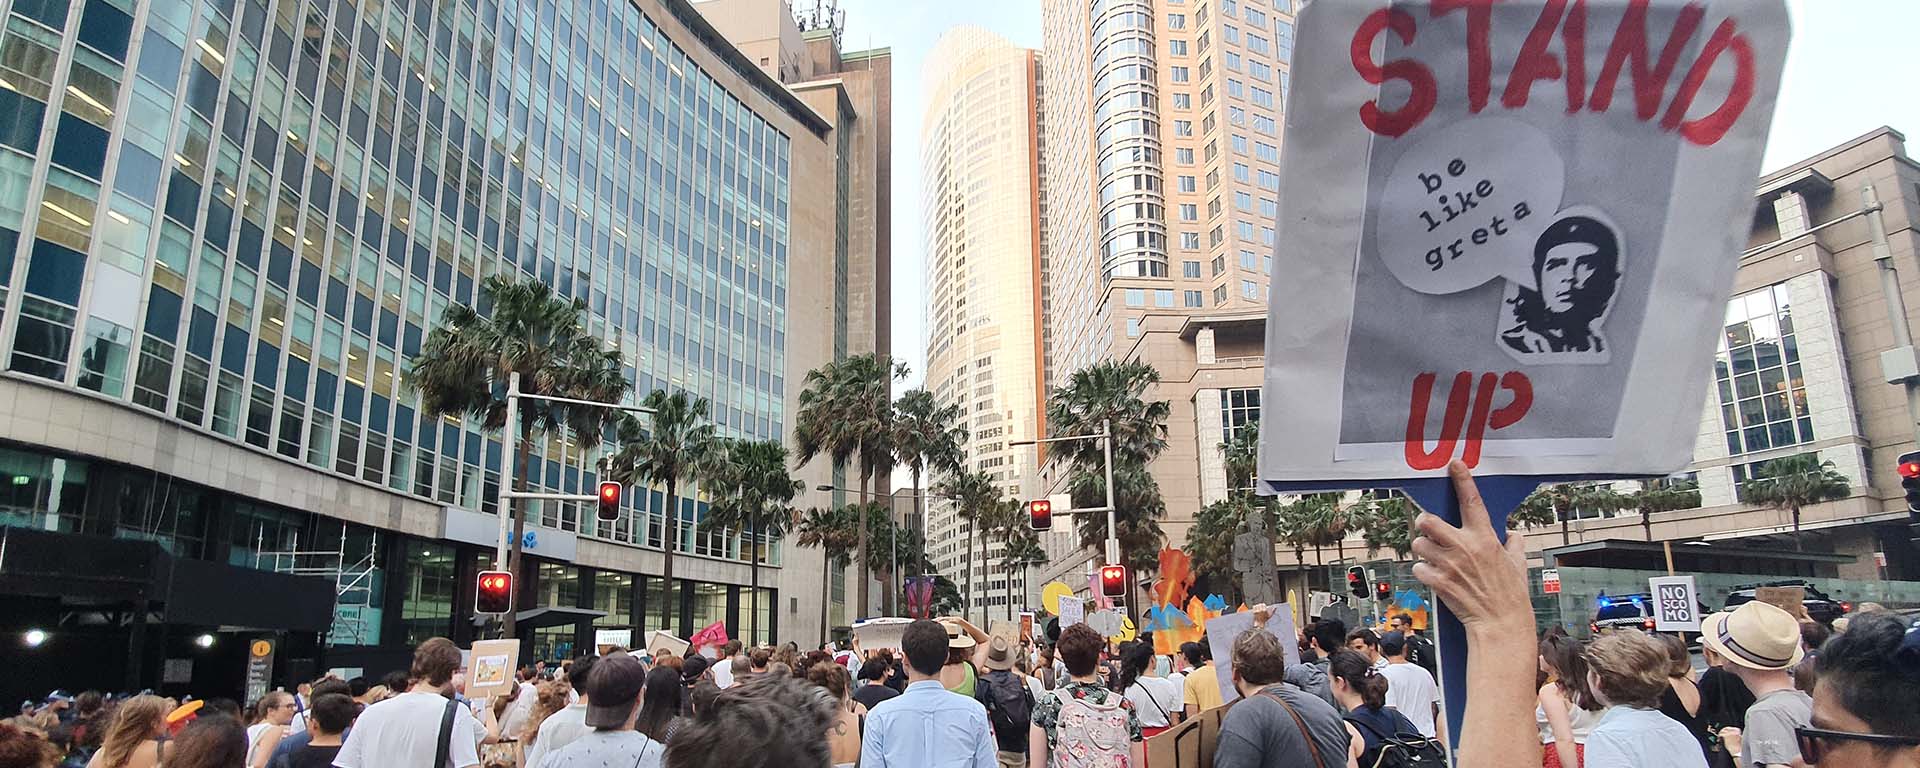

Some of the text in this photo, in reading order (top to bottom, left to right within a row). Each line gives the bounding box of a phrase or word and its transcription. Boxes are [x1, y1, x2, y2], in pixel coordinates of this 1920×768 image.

[1351, 0, 1755, 145] STAND
[1418, 158, 1466, 194] be
[1419, 179, 1494, 232] like
[1425, 202, 1532, 271] greta
[1405, 370, 1533, 471] UP
[1661, 586, 1686, 600] NO
[1663, 599, 1687, 610] SCO
[1665, 609, 1690, 621] MO
